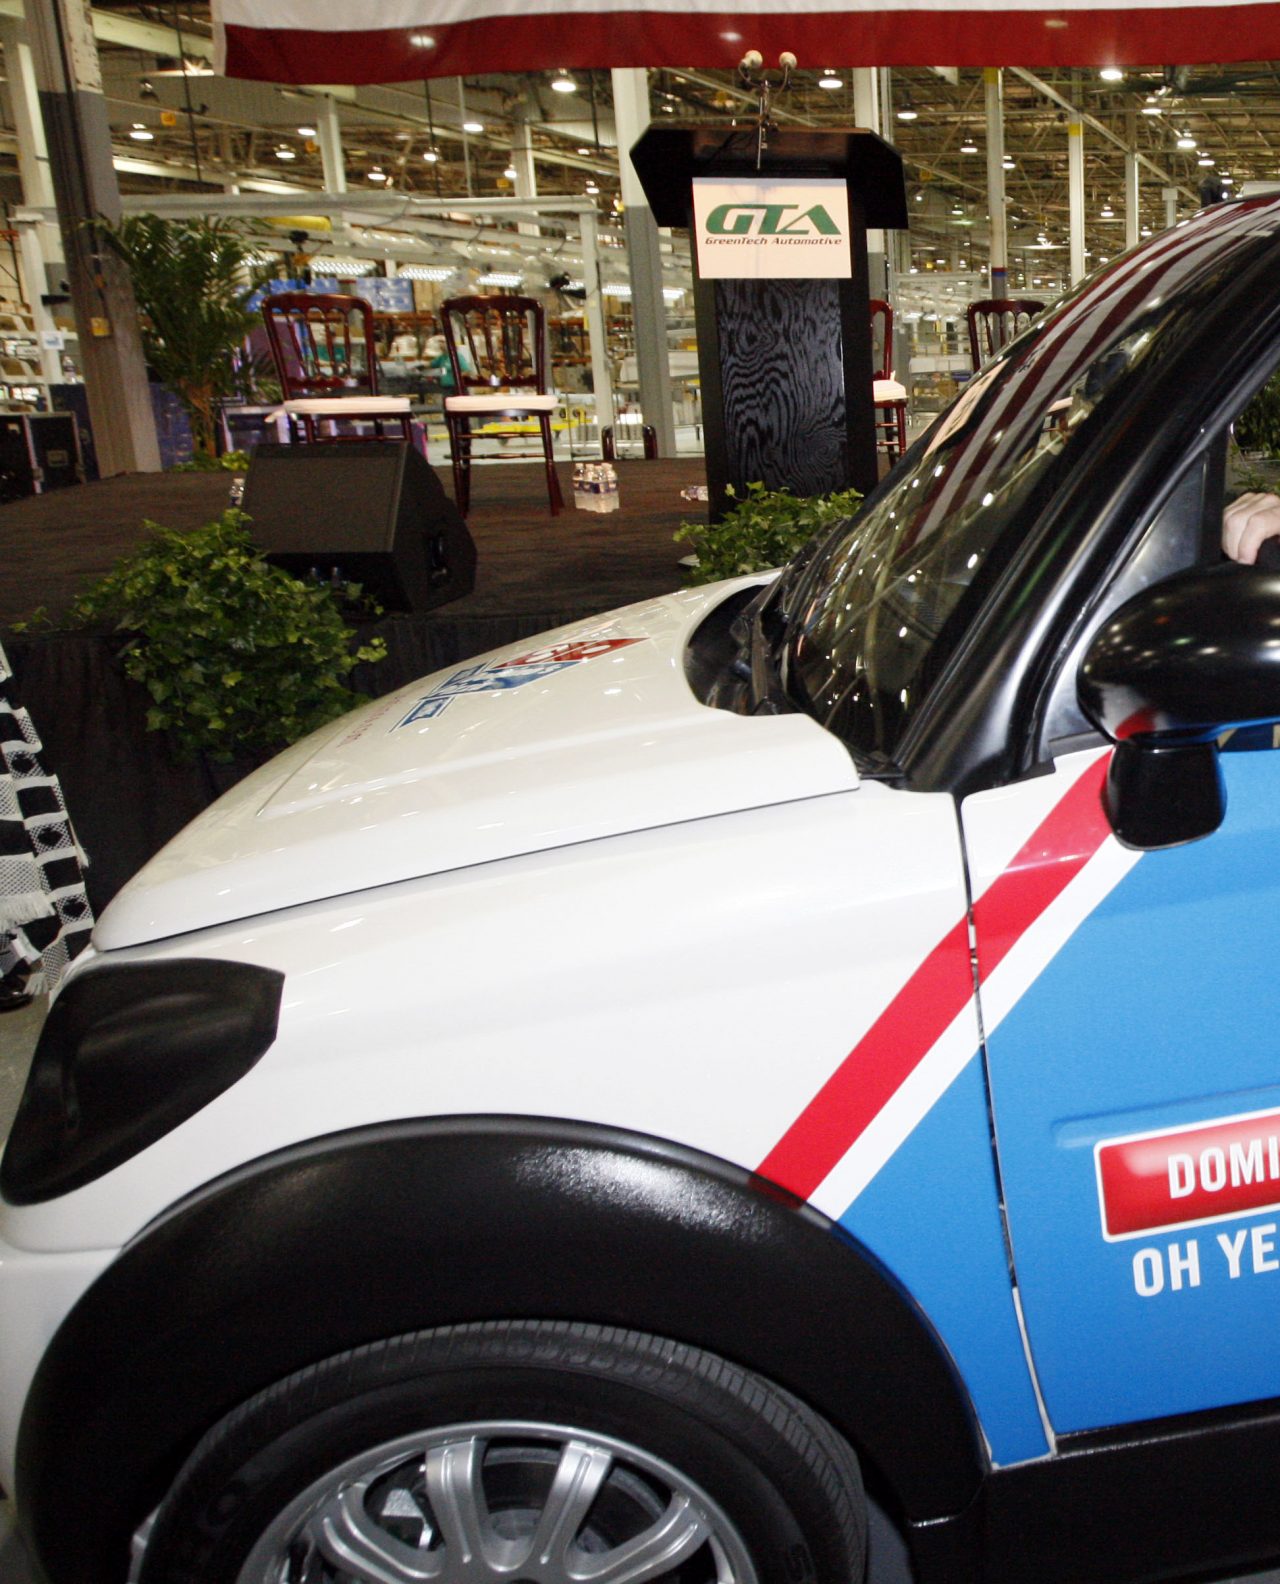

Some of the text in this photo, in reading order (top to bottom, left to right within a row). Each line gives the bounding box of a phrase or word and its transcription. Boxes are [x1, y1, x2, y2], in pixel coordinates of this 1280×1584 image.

[705, 203, 842, 235] GTA
[704, 237, 842, 245] GreenTech Automotive
[1132, 1239, 1200, 1297] OH
